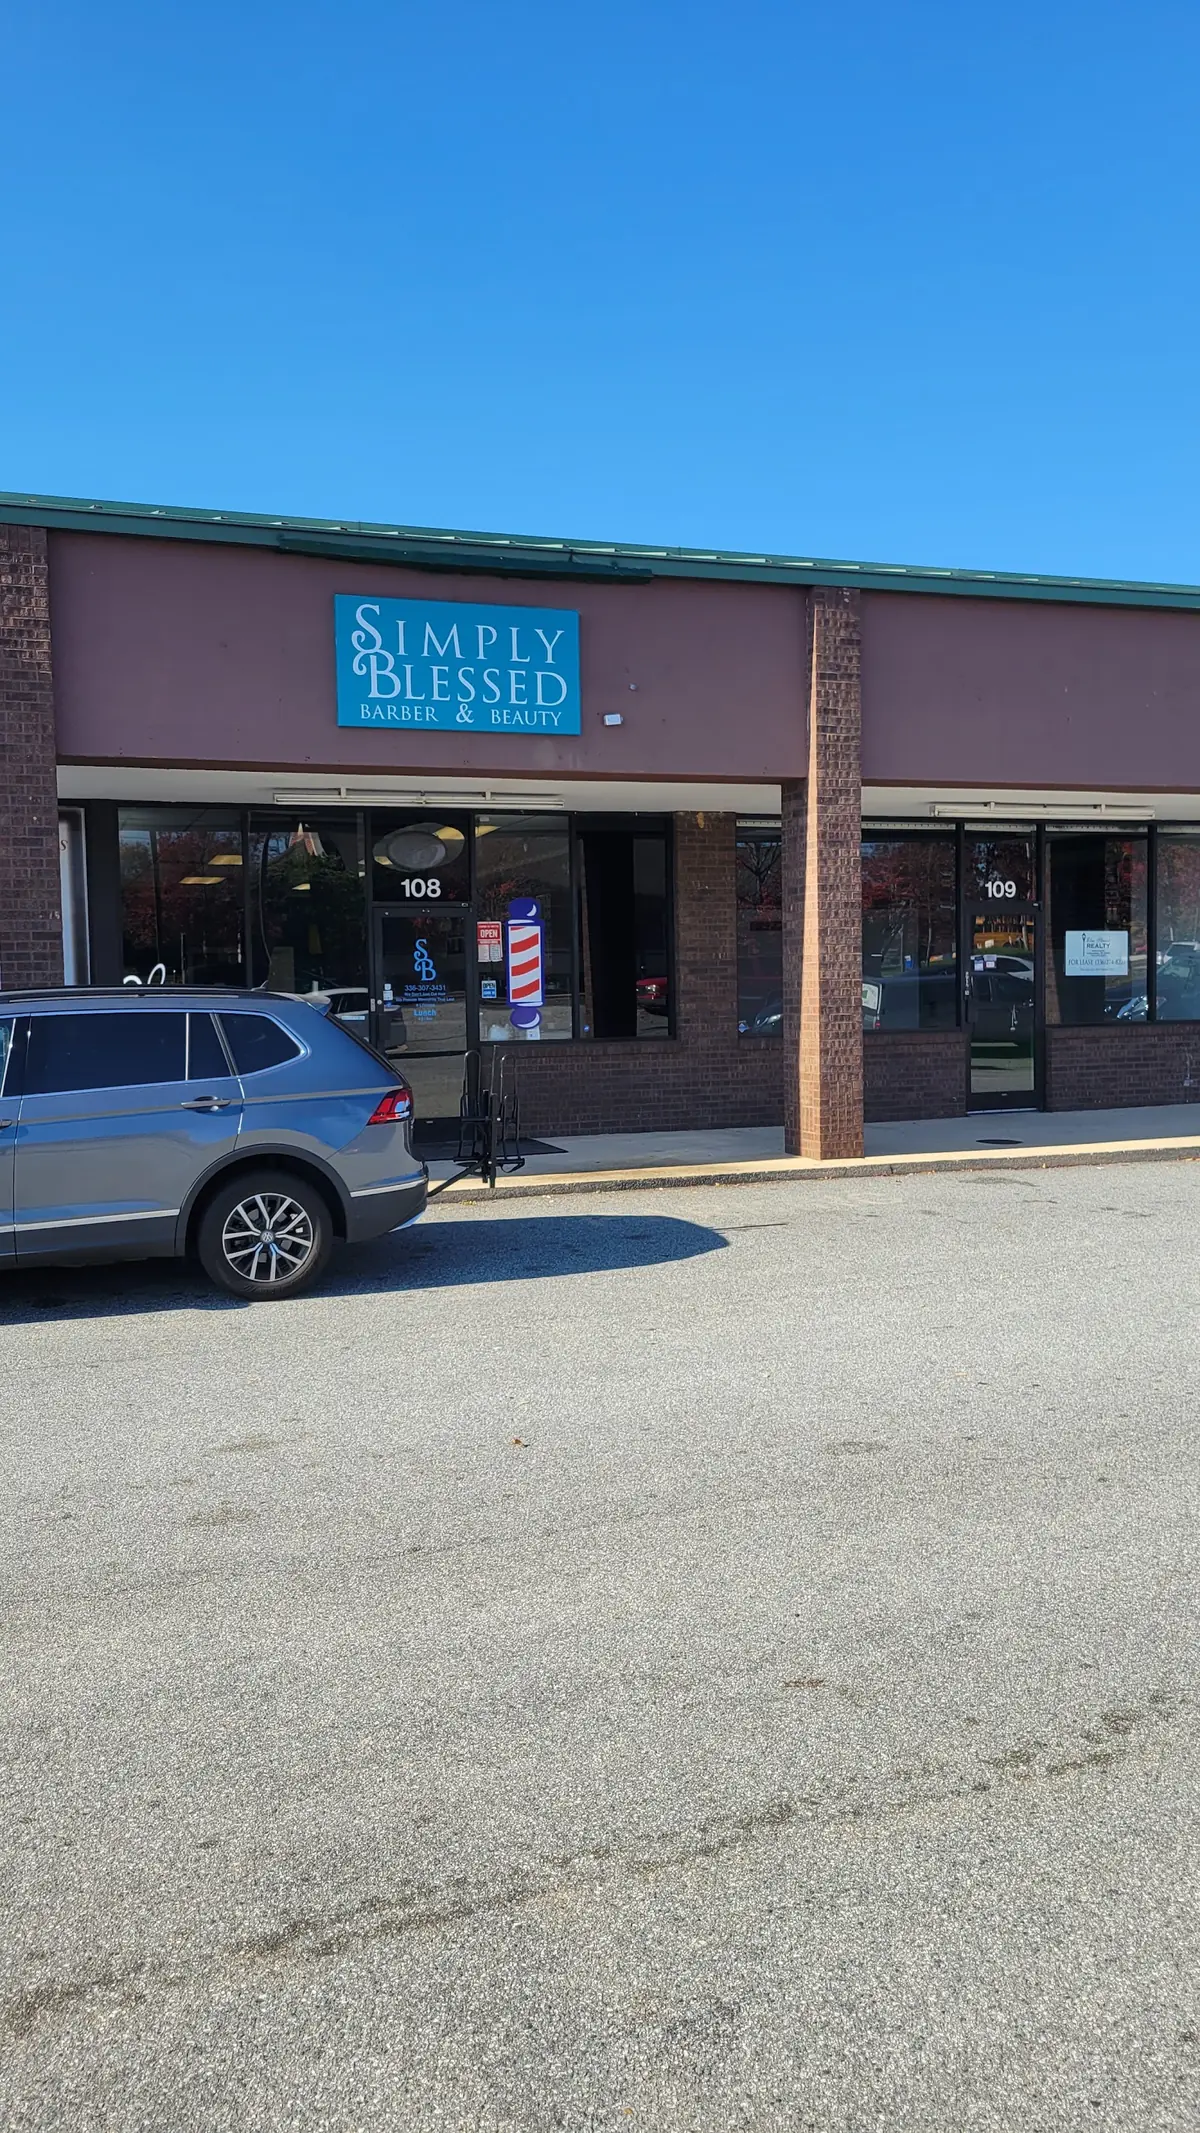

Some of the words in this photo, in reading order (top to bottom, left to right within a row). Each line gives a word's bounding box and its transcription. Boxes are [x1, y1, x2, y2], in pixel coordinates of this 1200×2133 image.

[351, 603, 565, 664] SIMPLY
[352, 649, 568, 707] BLESSED
[360, 703, 439, 722] BARBER
[455, 703, 475, 724] &
[491, 709, 562, 726] BEAUTY
[400, 878, 441, 898] 108
[984, 880, 1017, 898] 109
[480, 929, 498, 938] OPEN
